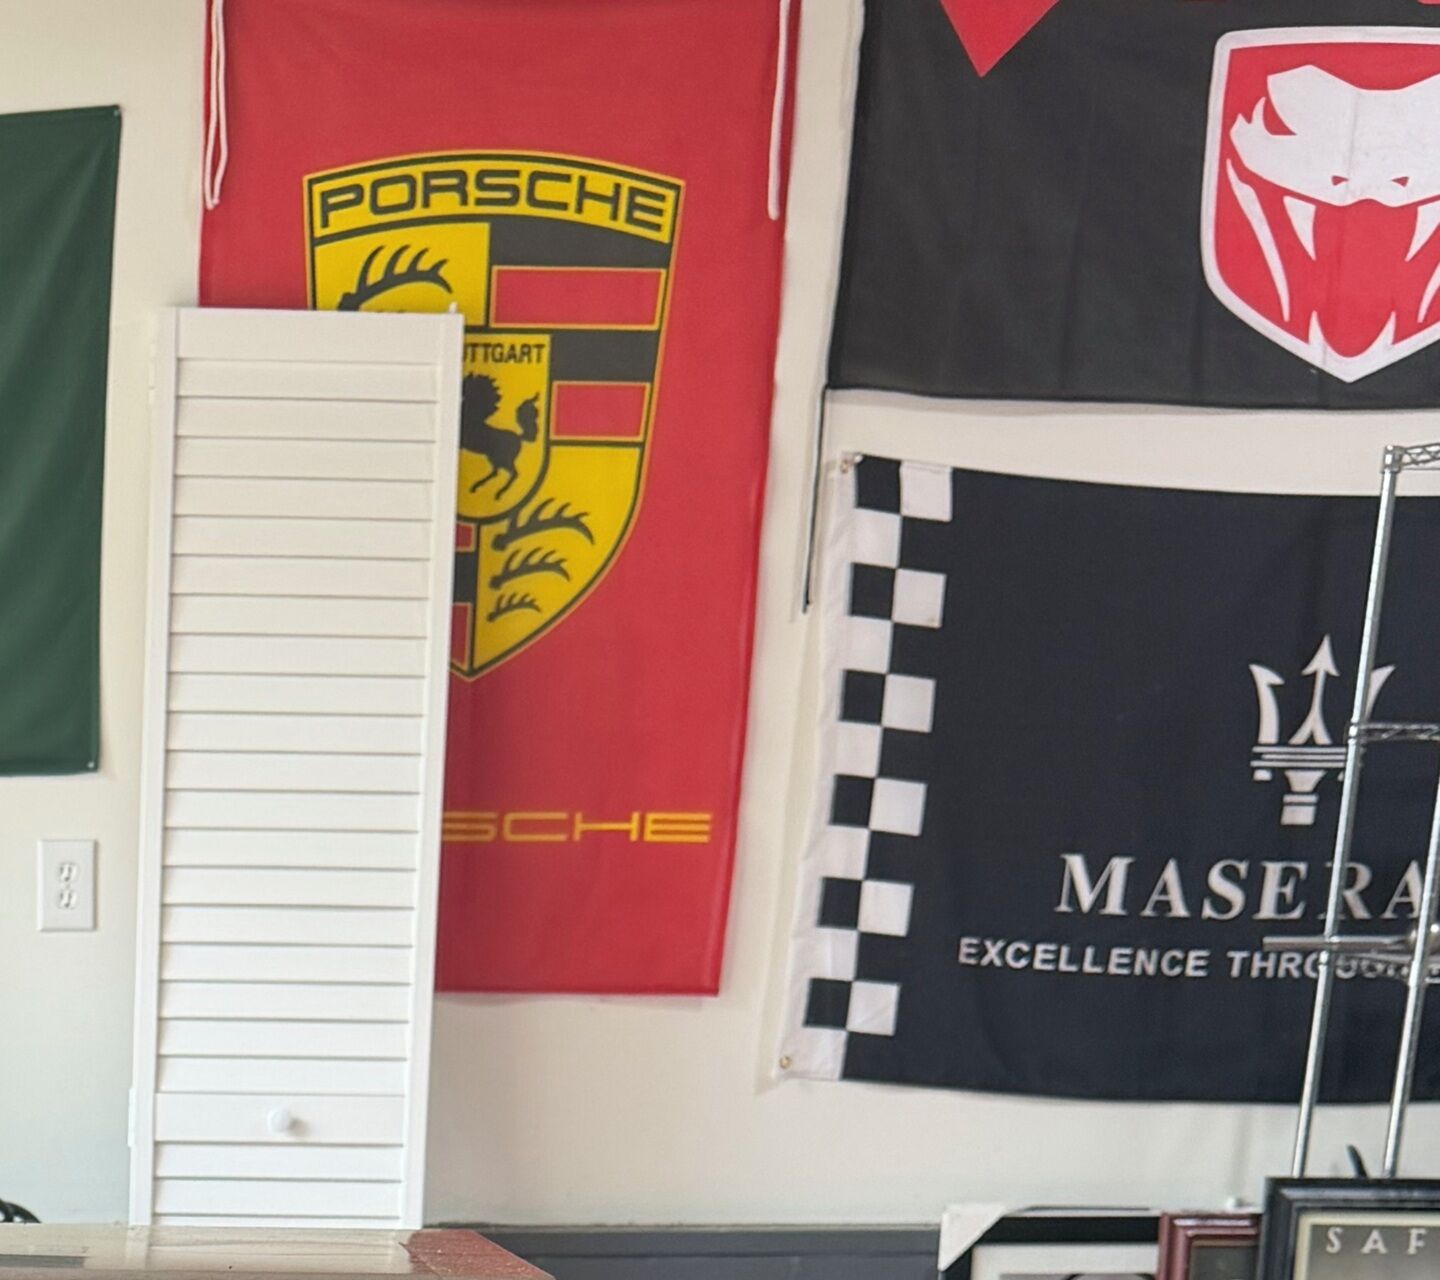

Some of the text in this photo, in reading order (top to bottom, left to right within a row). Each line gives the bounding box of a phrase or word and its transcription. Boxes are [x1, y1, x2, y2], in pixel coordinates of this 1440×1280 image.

[319, 168, 667, 233] PORSCHE
[958, 936, 1211, 978] EXCELLENCE
[1325, 1226, 1428, 1255] SAF
